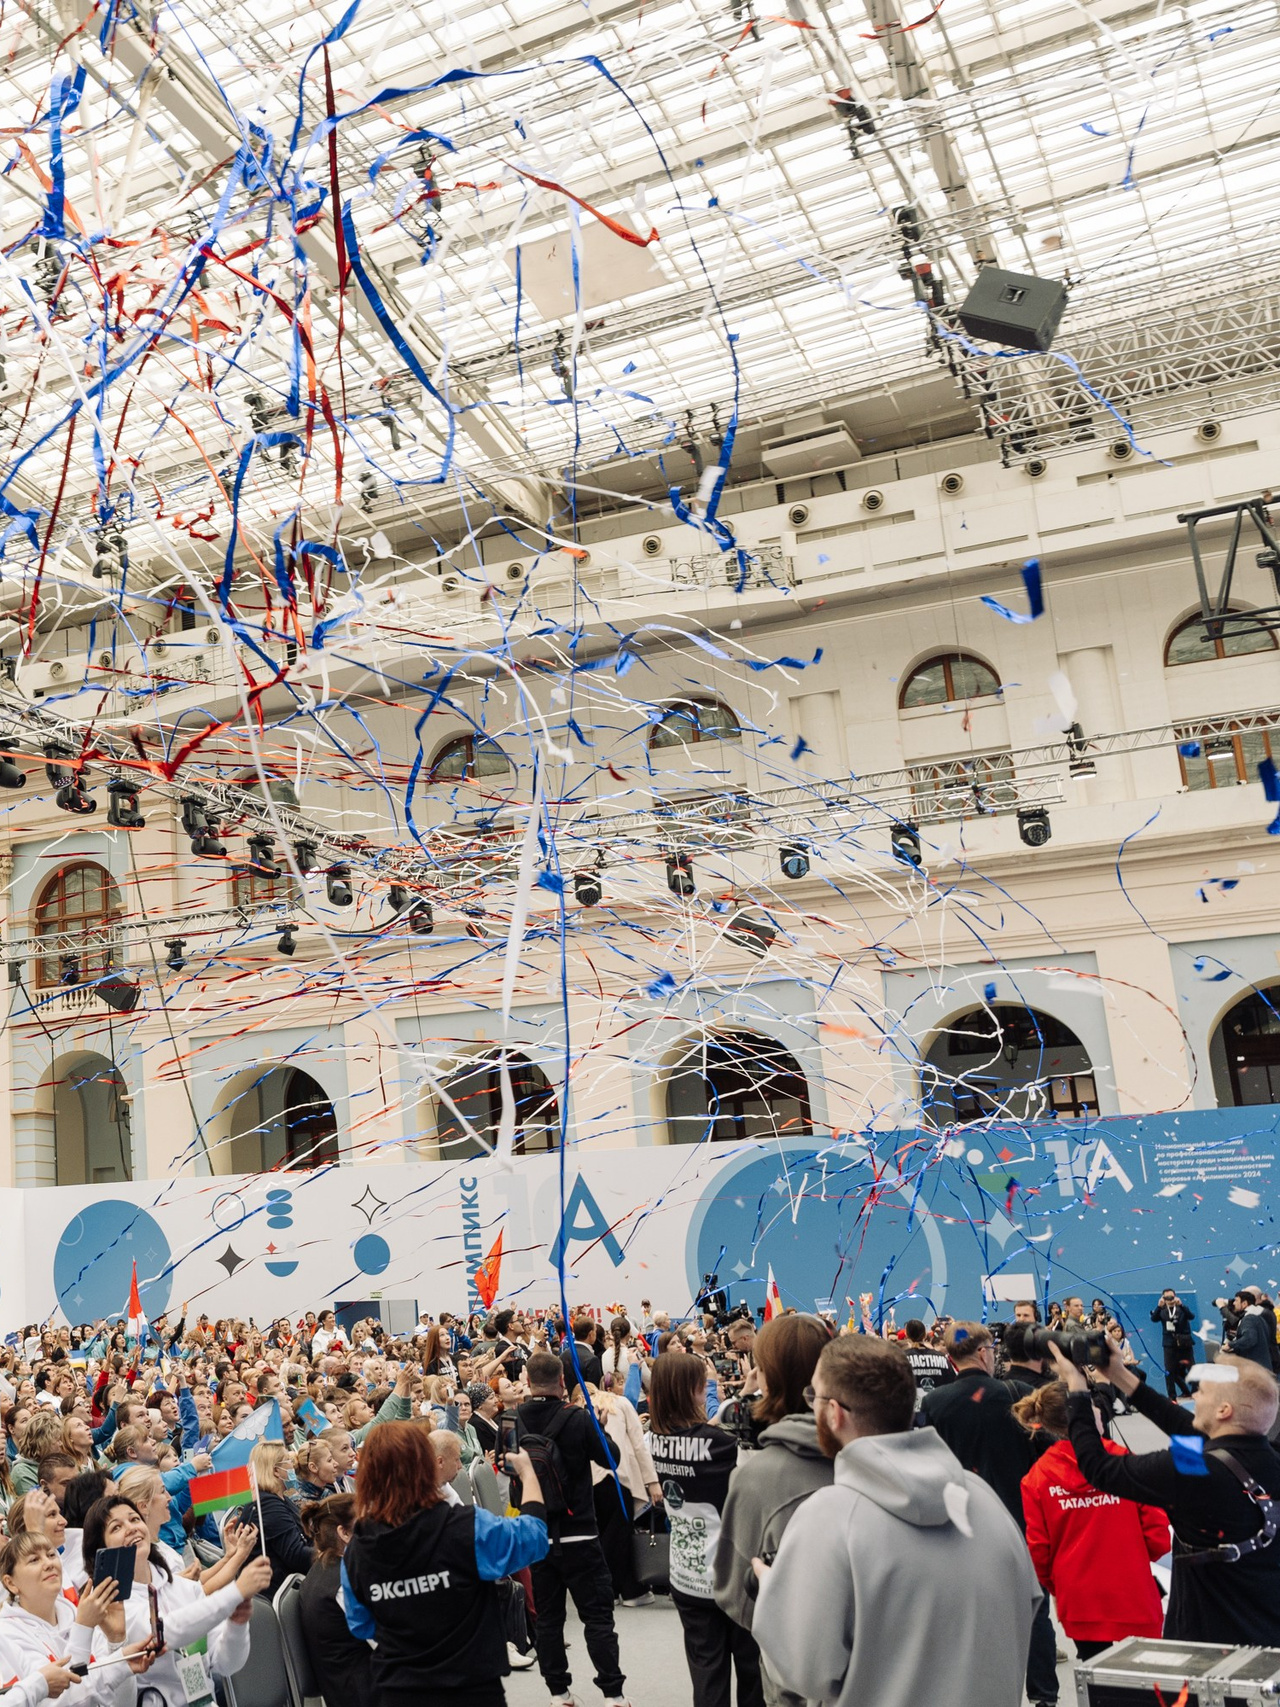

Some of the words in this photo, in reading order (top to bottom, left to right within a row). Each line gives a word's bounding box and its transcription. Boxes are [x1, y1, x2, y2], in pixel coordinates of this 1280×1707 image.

[1242, 1170, 1261, 1178] 2024
[1058, 1493, 1121, 1510] ТАТАРСТАН
[369, 1570, 450, 1602] ЭКСПЕРТ
